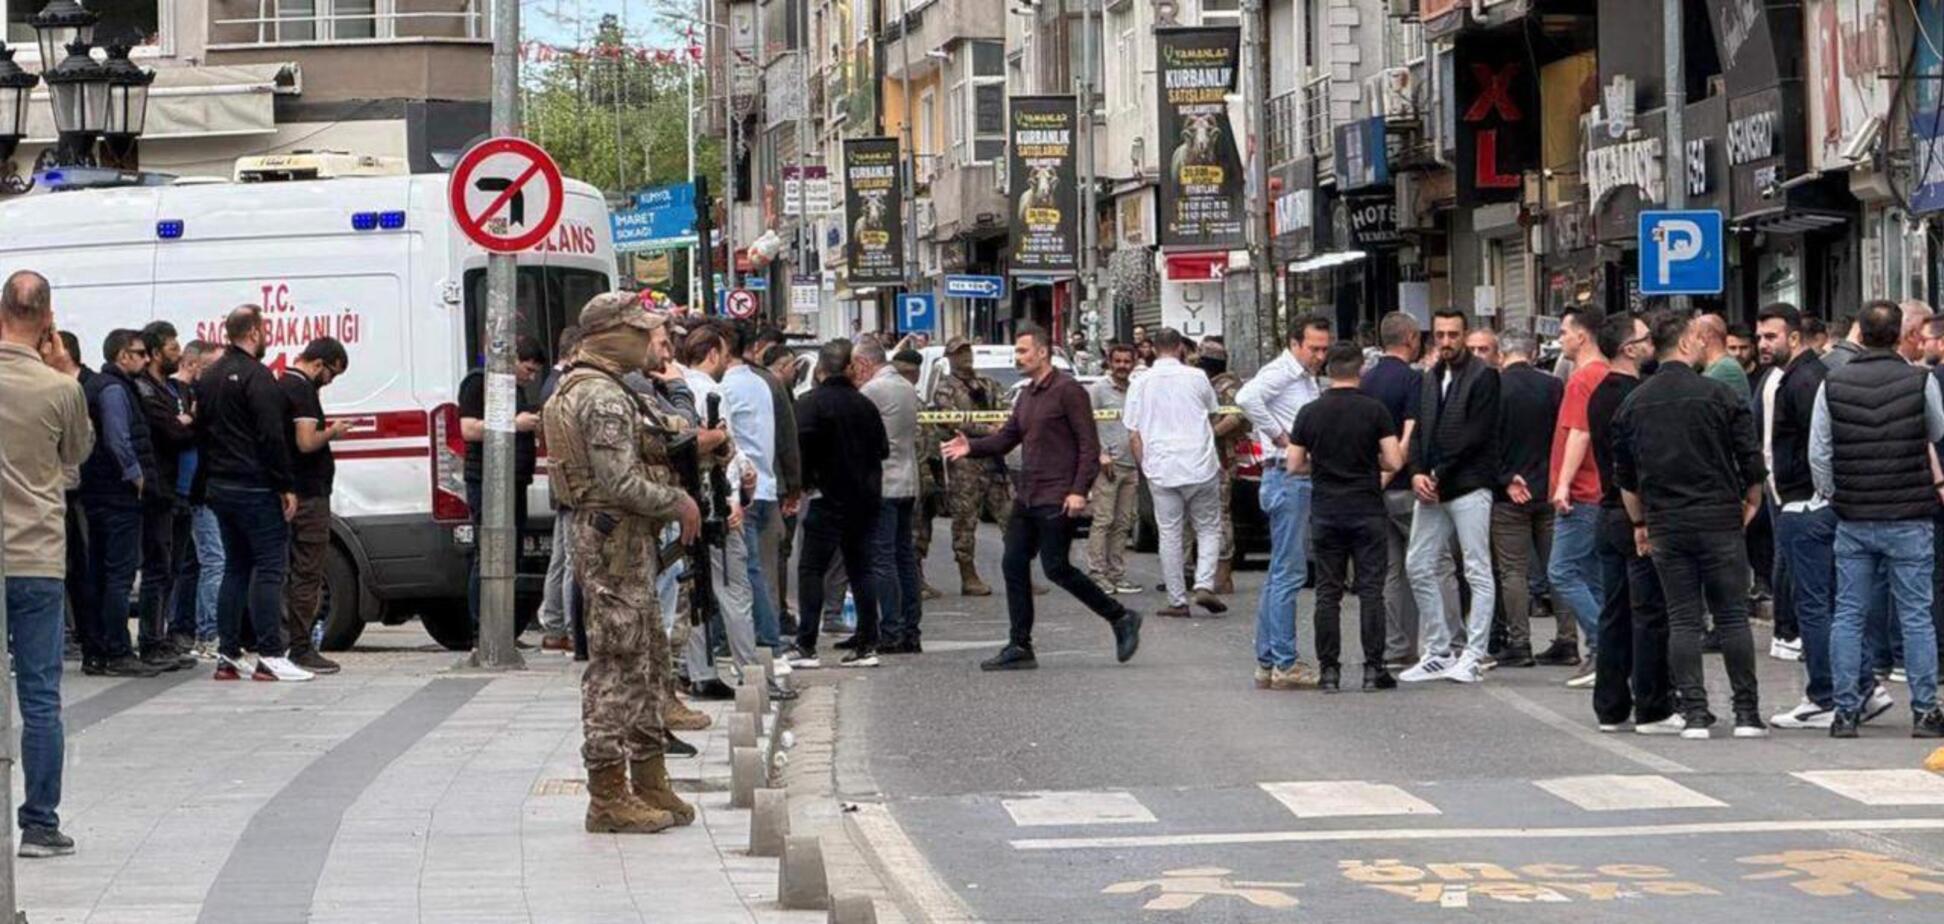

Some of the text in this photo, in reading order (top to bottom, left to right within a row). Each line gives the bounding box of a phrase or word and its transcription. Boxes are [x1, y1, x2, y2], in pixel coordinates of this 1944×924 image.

[1165, 67, 1233, 88] KURBANLIK
[1016, 130, 1070, 145] KURBANLIK
[1658, 219, 1703, 285] P
[261, 284, 295, 313] T.C.
[906, 297, 927, 328] P
[196, 314, 230, 348] SAĞ
